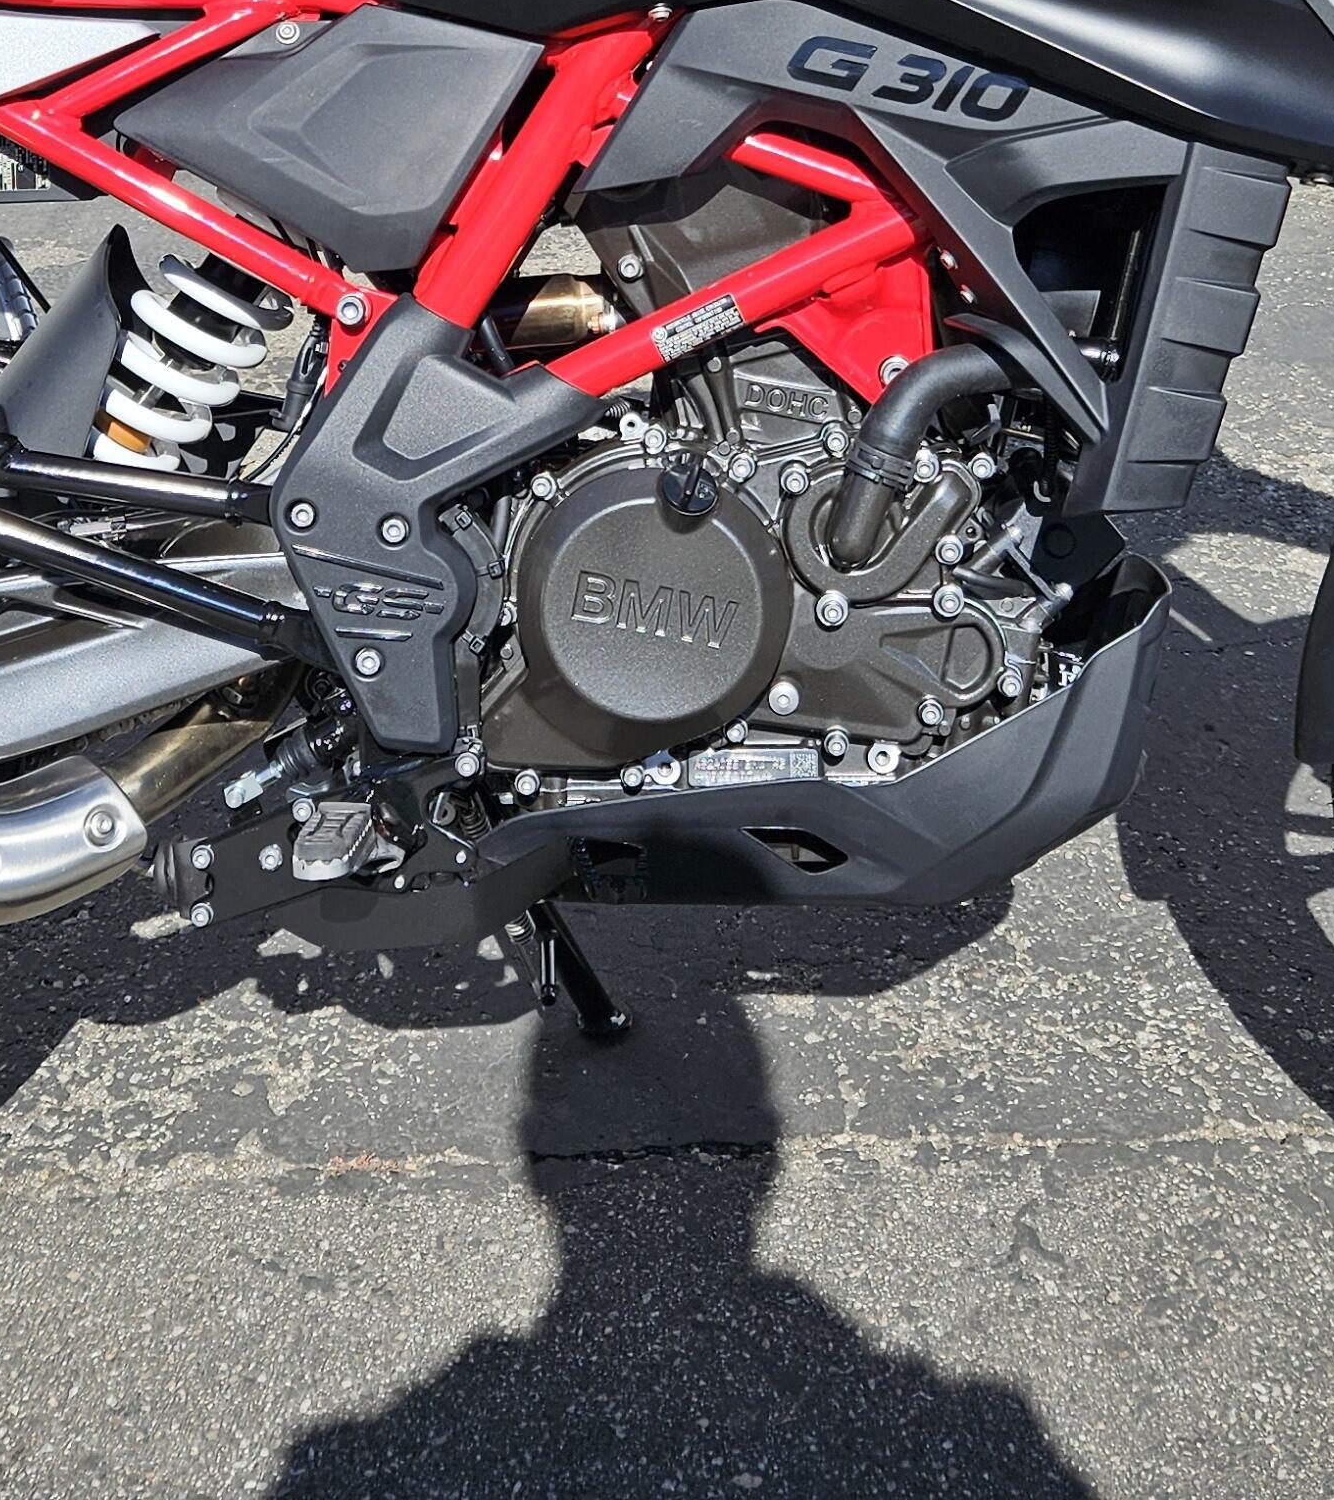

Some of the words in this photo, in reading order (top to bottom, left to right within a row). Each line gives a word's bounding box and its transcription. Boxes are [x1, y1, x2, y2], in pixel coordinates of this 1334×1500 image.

[786, 35, 877, 92] G
[873, 54, 1030, 122] 310
[744, 382, 829, 421] DOHC
[331, 581, 430, 621] GS
[571, 569, 739, 651] BMW
